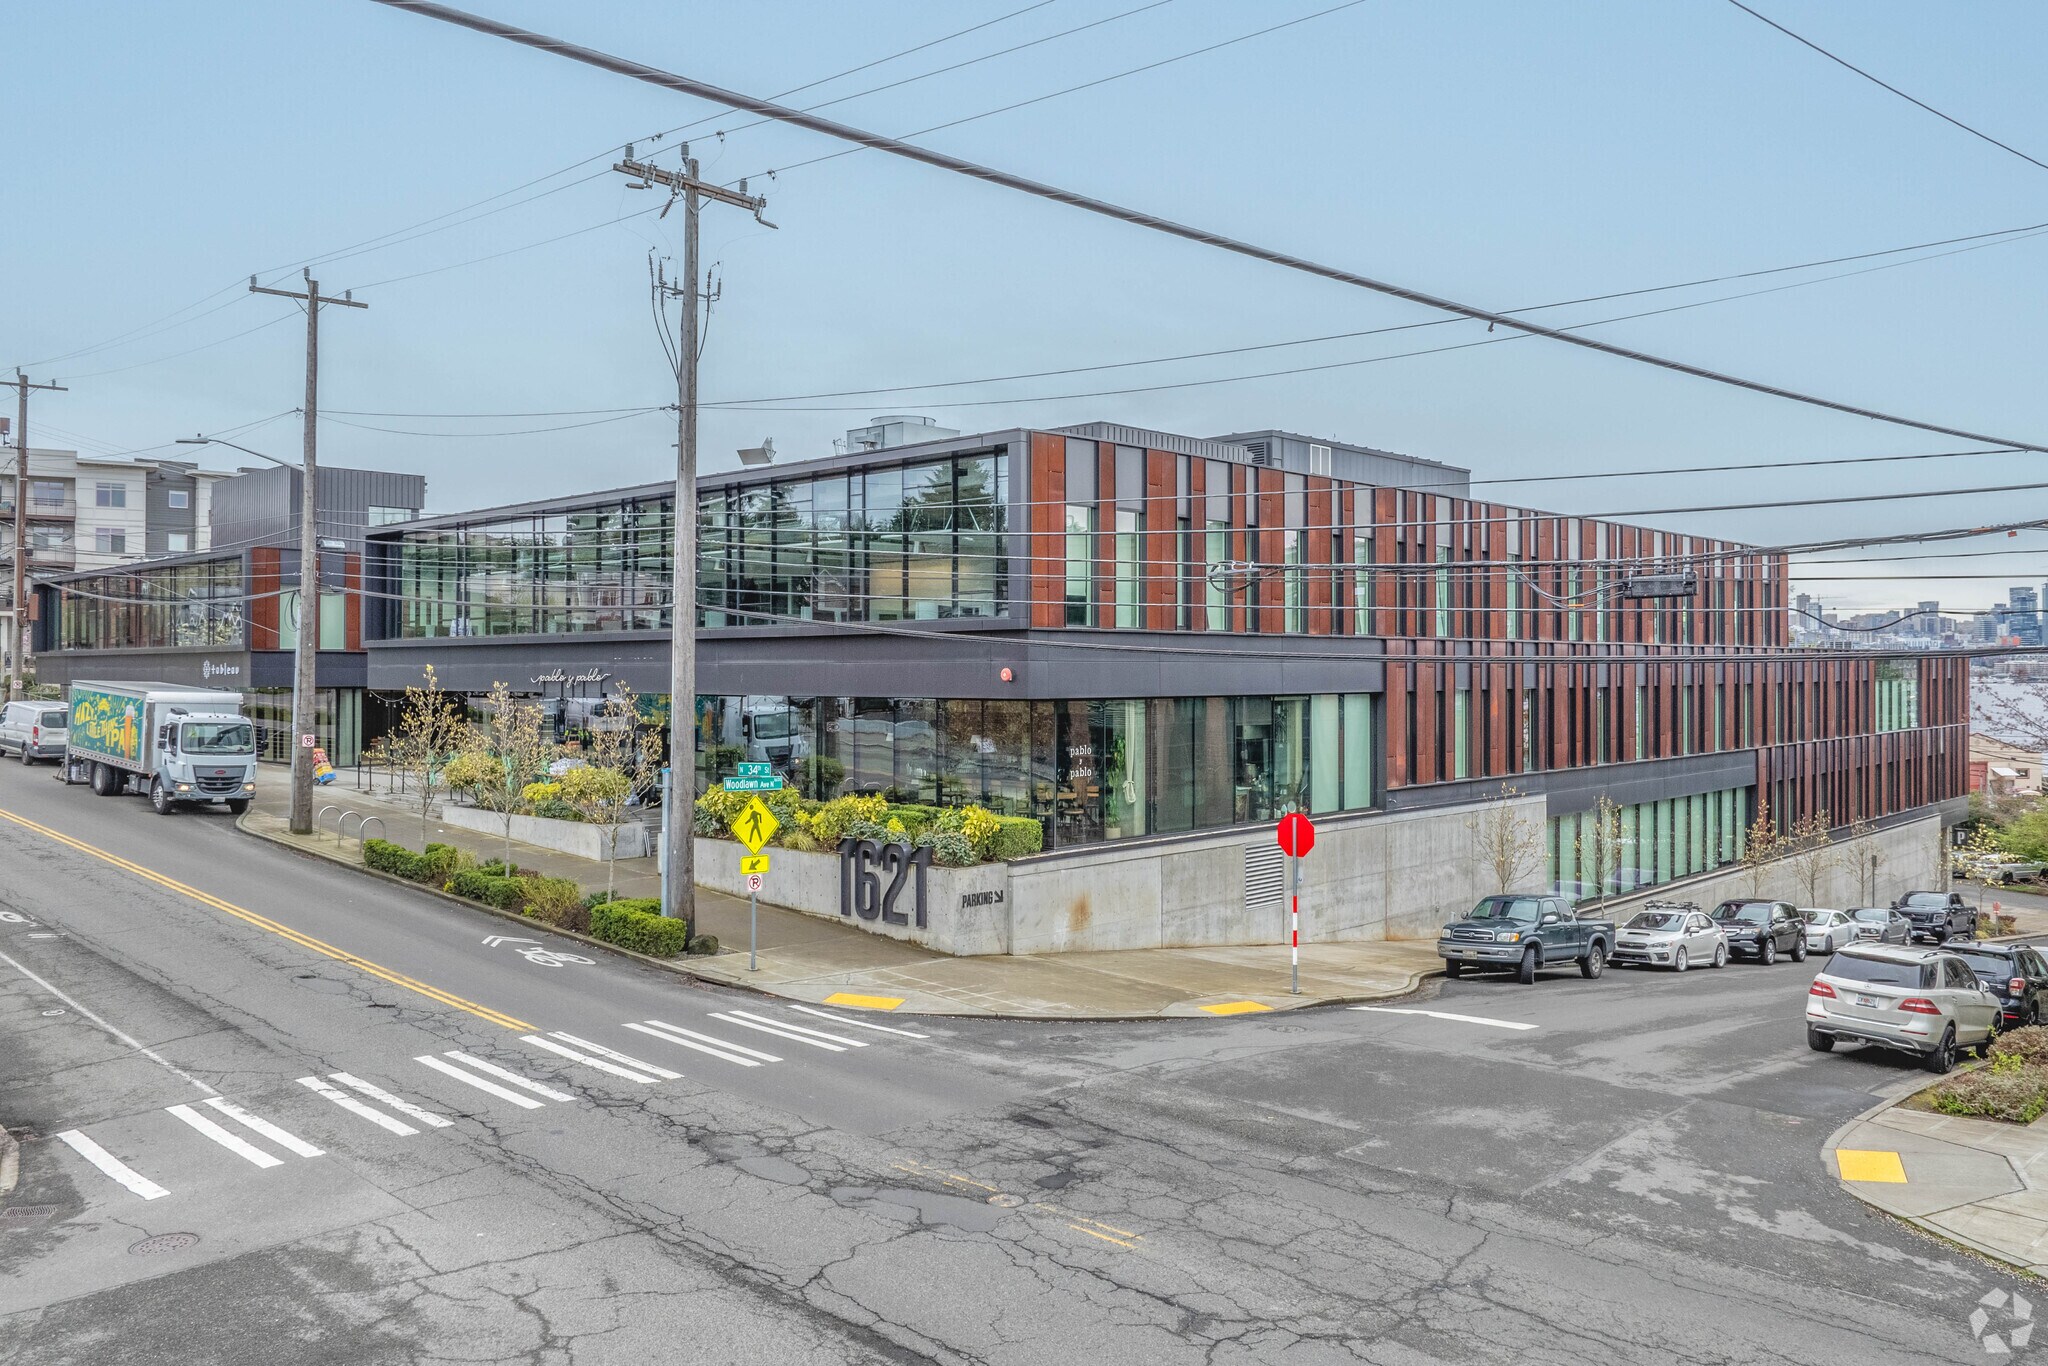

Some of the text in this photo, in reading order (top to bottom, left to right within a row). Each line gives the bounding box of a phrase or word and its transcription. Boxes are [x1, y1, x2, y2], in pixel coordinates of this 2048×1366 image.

[211, 662, 240, 676] tableau
[530, 667, 612, 688] pablo y pablo
[1070, 745, 1092, 758] pablo
[1070, 766, 1092, 780] pablo
[725, 779, 759, 790] Woodlawn
[760, 781, 770, 789] Ave
[1957, 831, 1966, 845] P
[836, 836, 934, 929] 1621
[962, 890, 994, 909] PARKING
